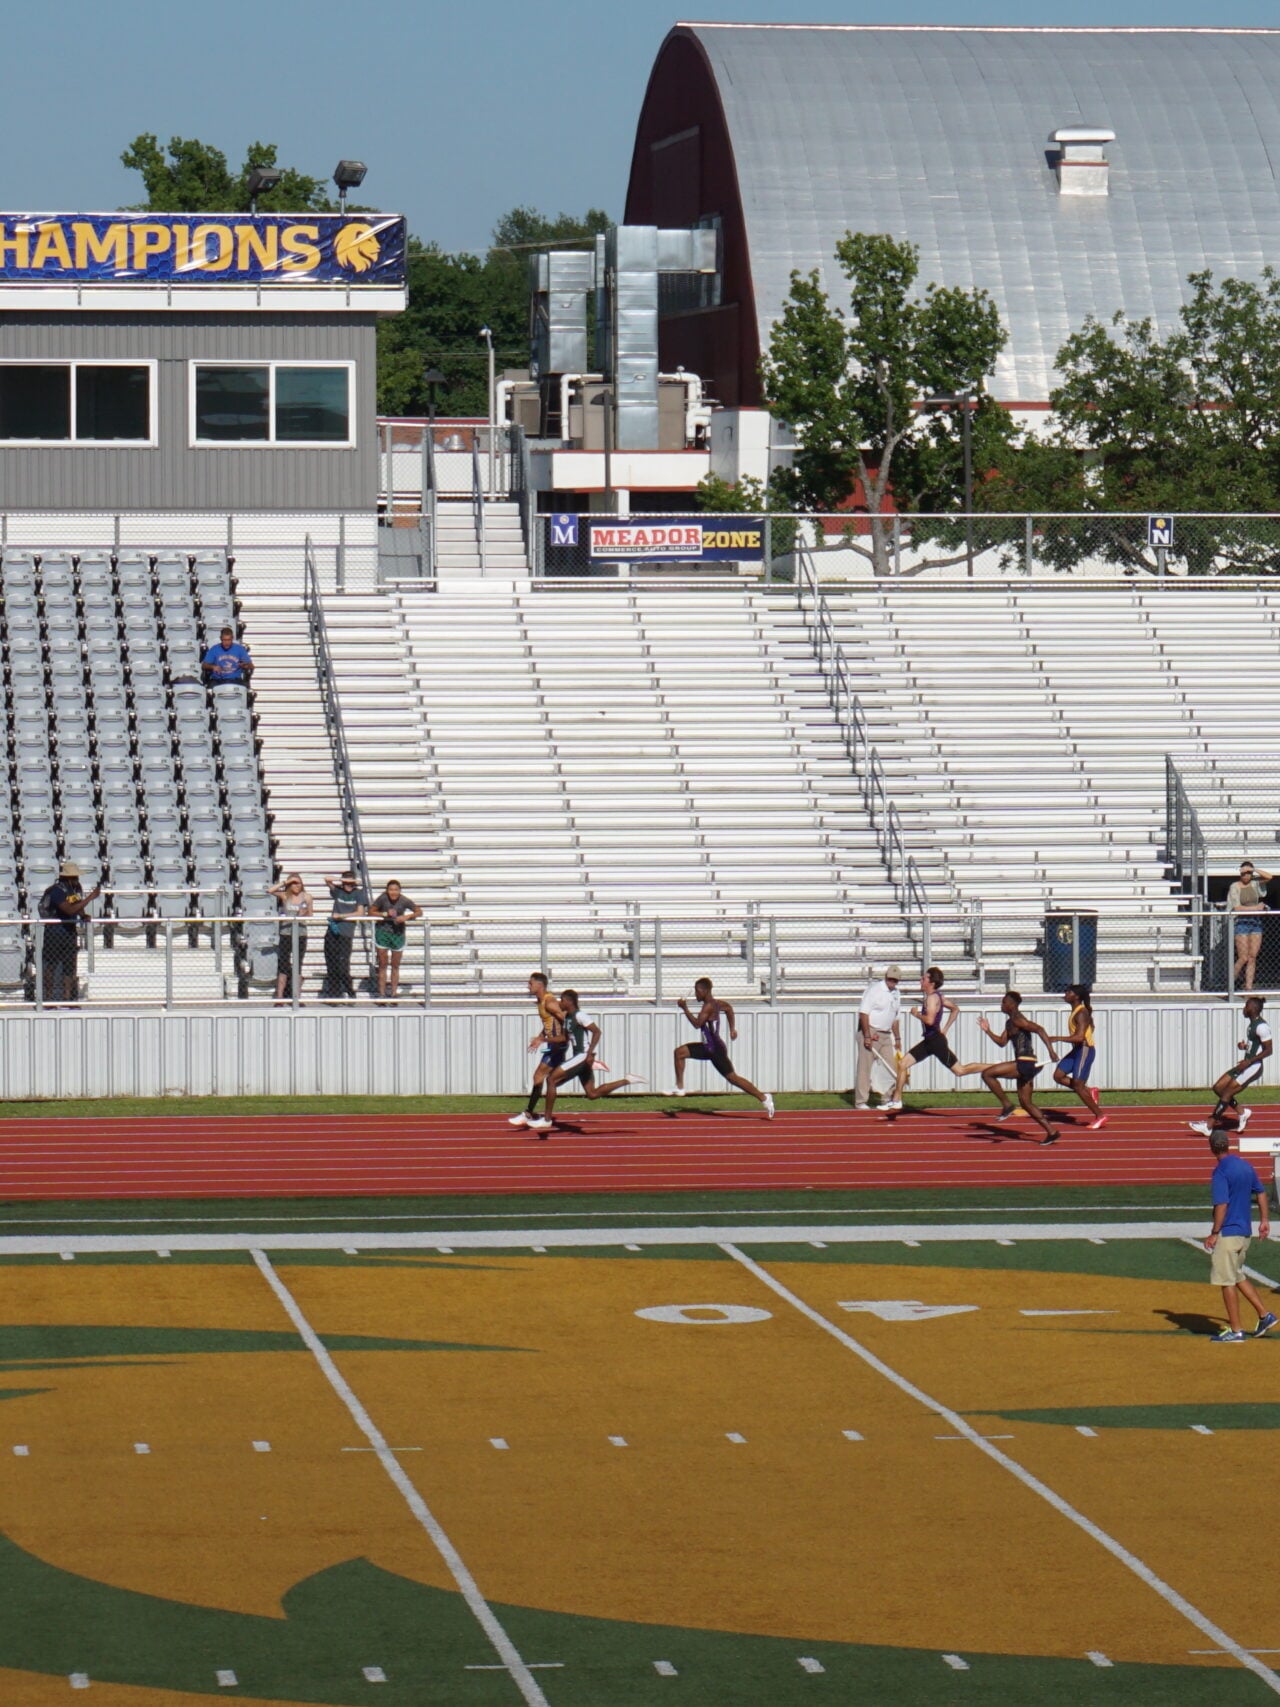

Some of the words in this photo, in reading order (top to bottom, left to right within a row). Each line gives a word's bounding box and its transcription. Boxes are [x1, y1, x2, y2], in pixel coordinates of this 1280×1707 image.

[553, 525, 576, 544] M
[593, 528, 700, 546] MEADOR
[703, 531, 761, 548] ZONE
[1151, 529, 1170, 544] N
